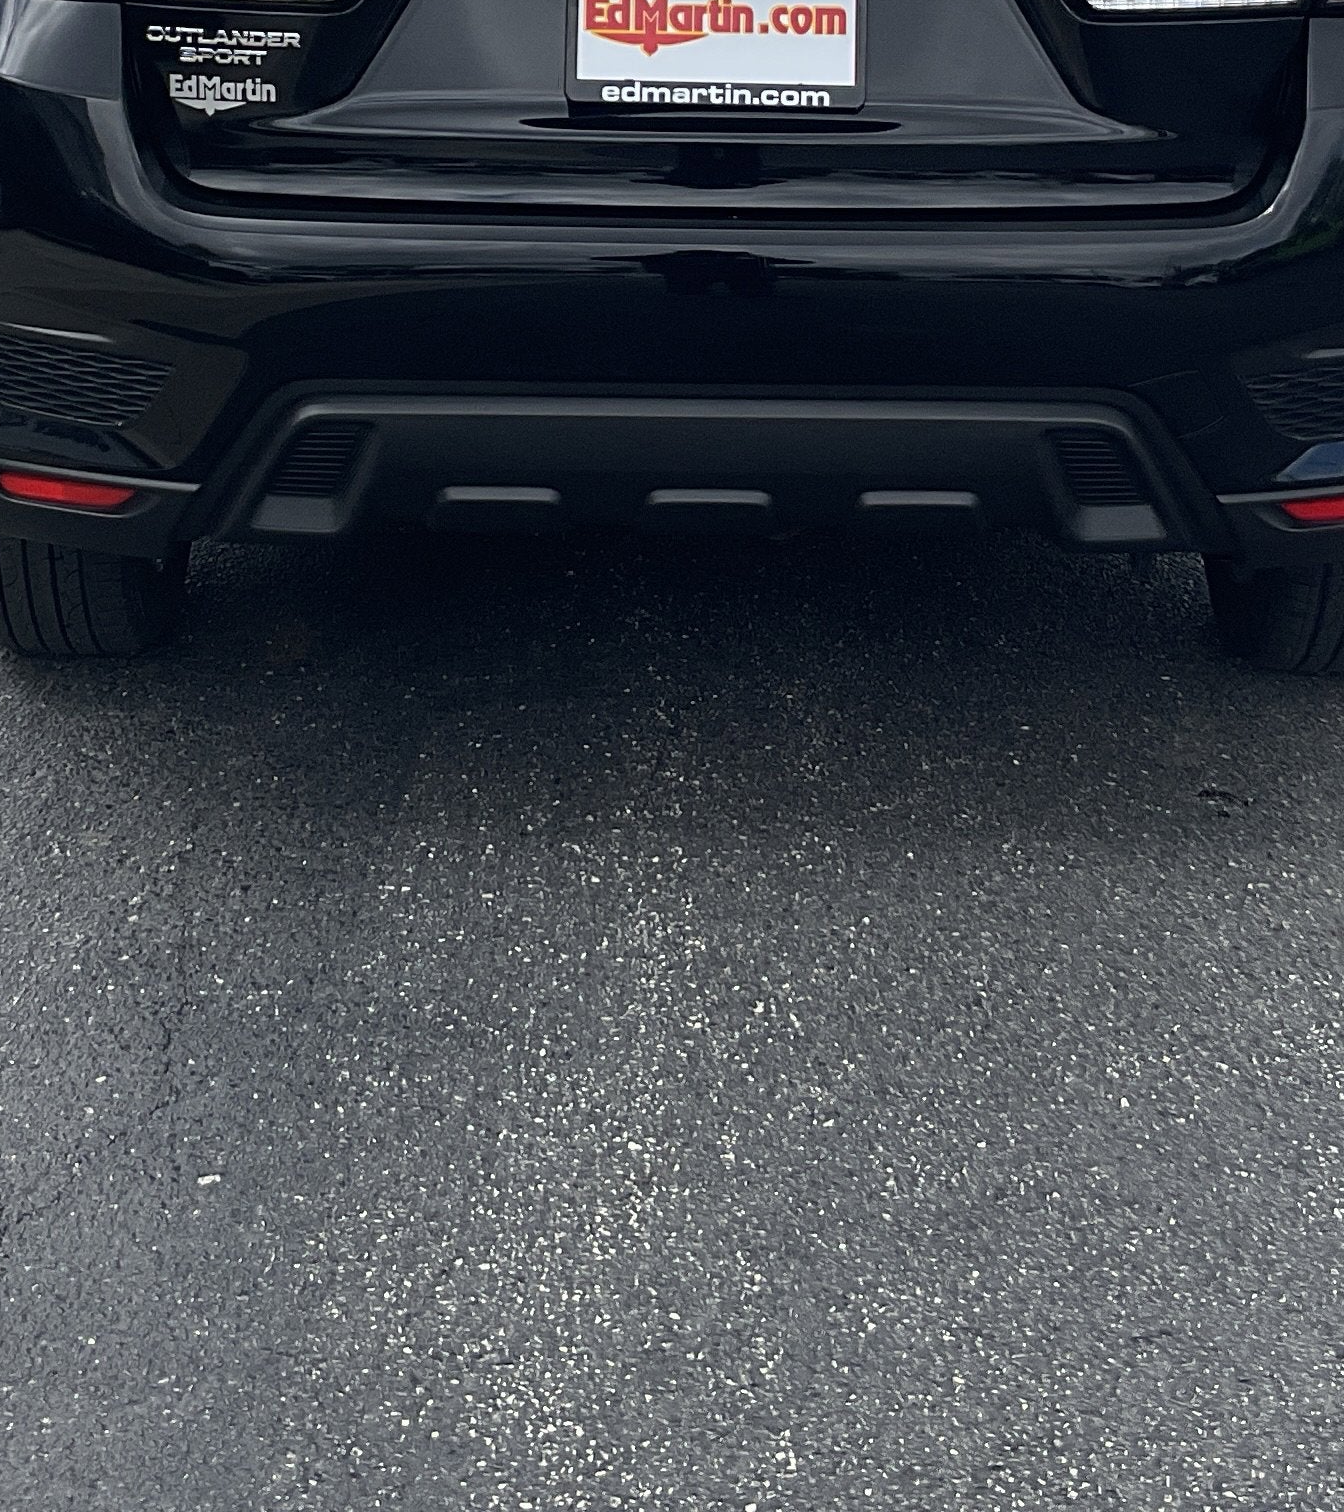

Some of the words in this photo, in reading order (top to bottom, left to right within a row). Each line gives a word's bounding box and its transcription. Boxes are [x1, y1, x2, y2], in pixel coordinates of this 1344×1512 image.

[145, 25, 302, 49] OUTLANDER
[178, 46, 268, 66] SPORT
[168, 73, 278, 110] EdMartin
[601, 81, 831, 107] edmartin.com
